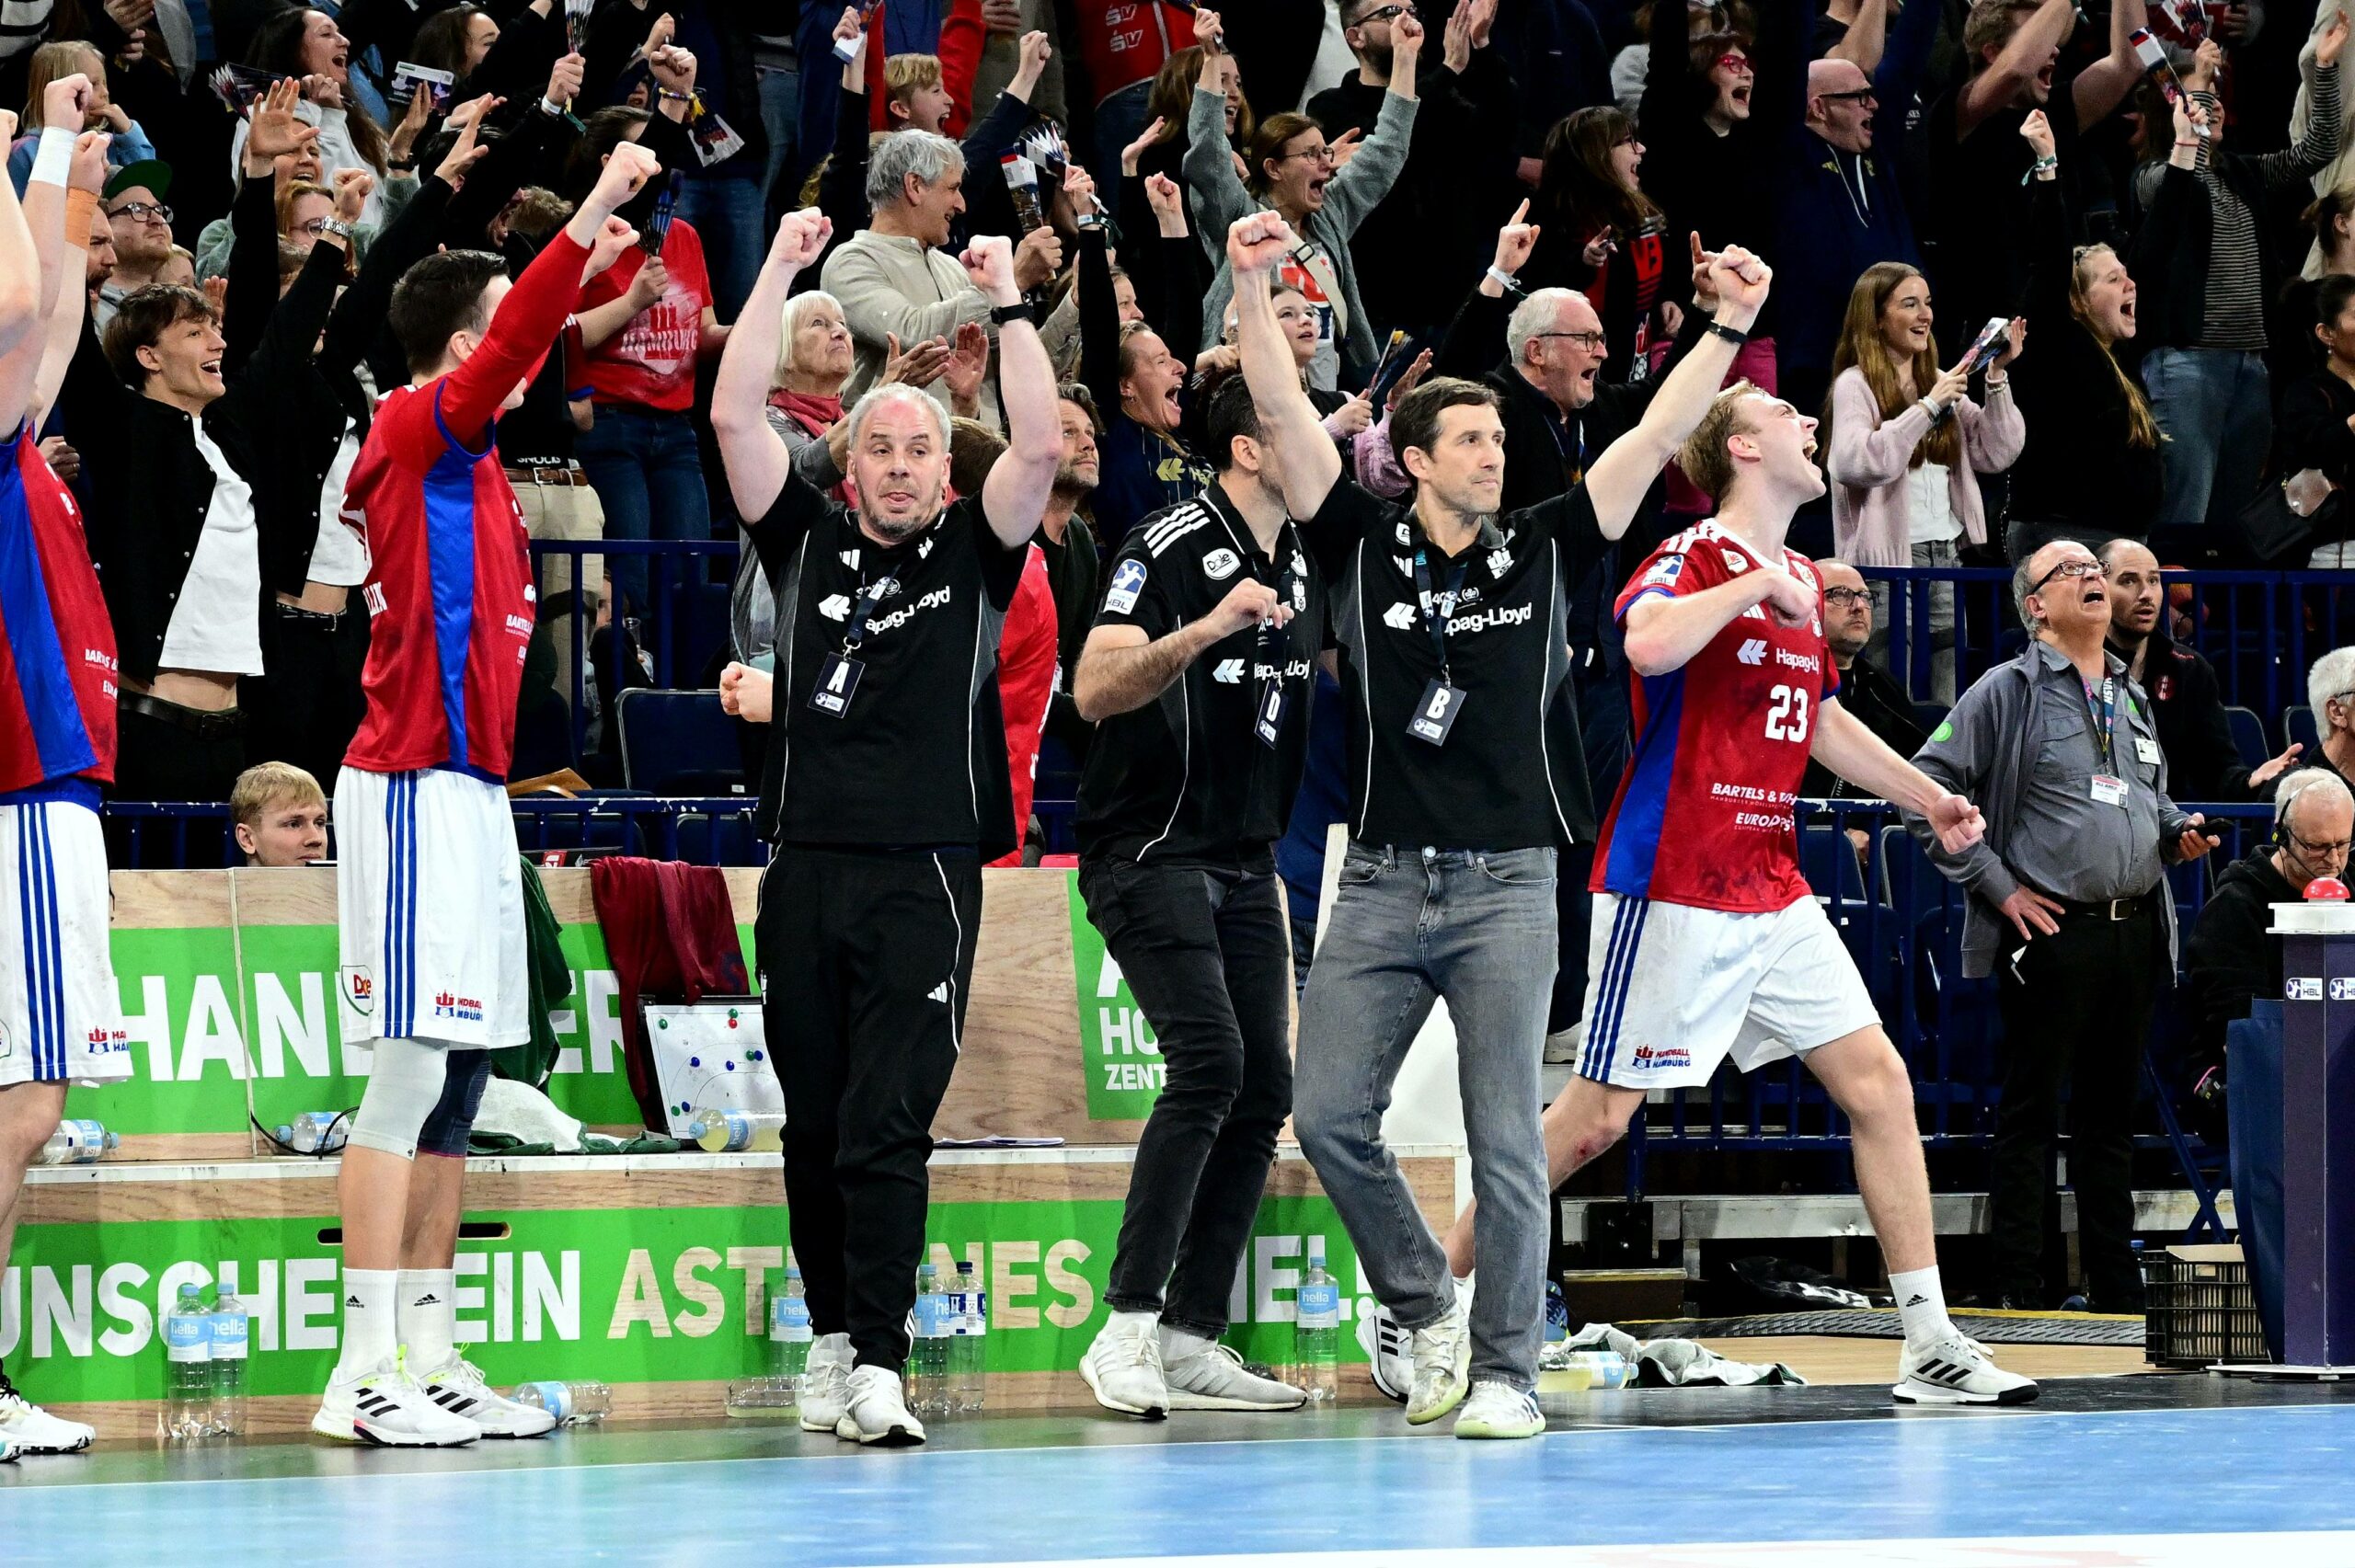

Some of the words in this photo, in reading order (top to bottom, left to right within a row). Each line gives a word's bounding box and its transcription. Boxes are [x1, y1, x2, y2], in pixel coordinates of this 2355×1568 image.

[827, 661, 850, 693] A
[1266, 690, 1281, 722] D
[1426, 687, 1451, 719] B
[1764, 684, 1808, 743] 23
[1712, 783, 1765, 802] BARTELS
[1767, 790, 1777, 803] &
[2303, 988, 2320, 997] HBL
[1656, 1048, 1690, 1059] HANDBALL
[1652, 1059, 1691, 1069] HAMBURG
[1303, 1290, 1329, 1303] hella
